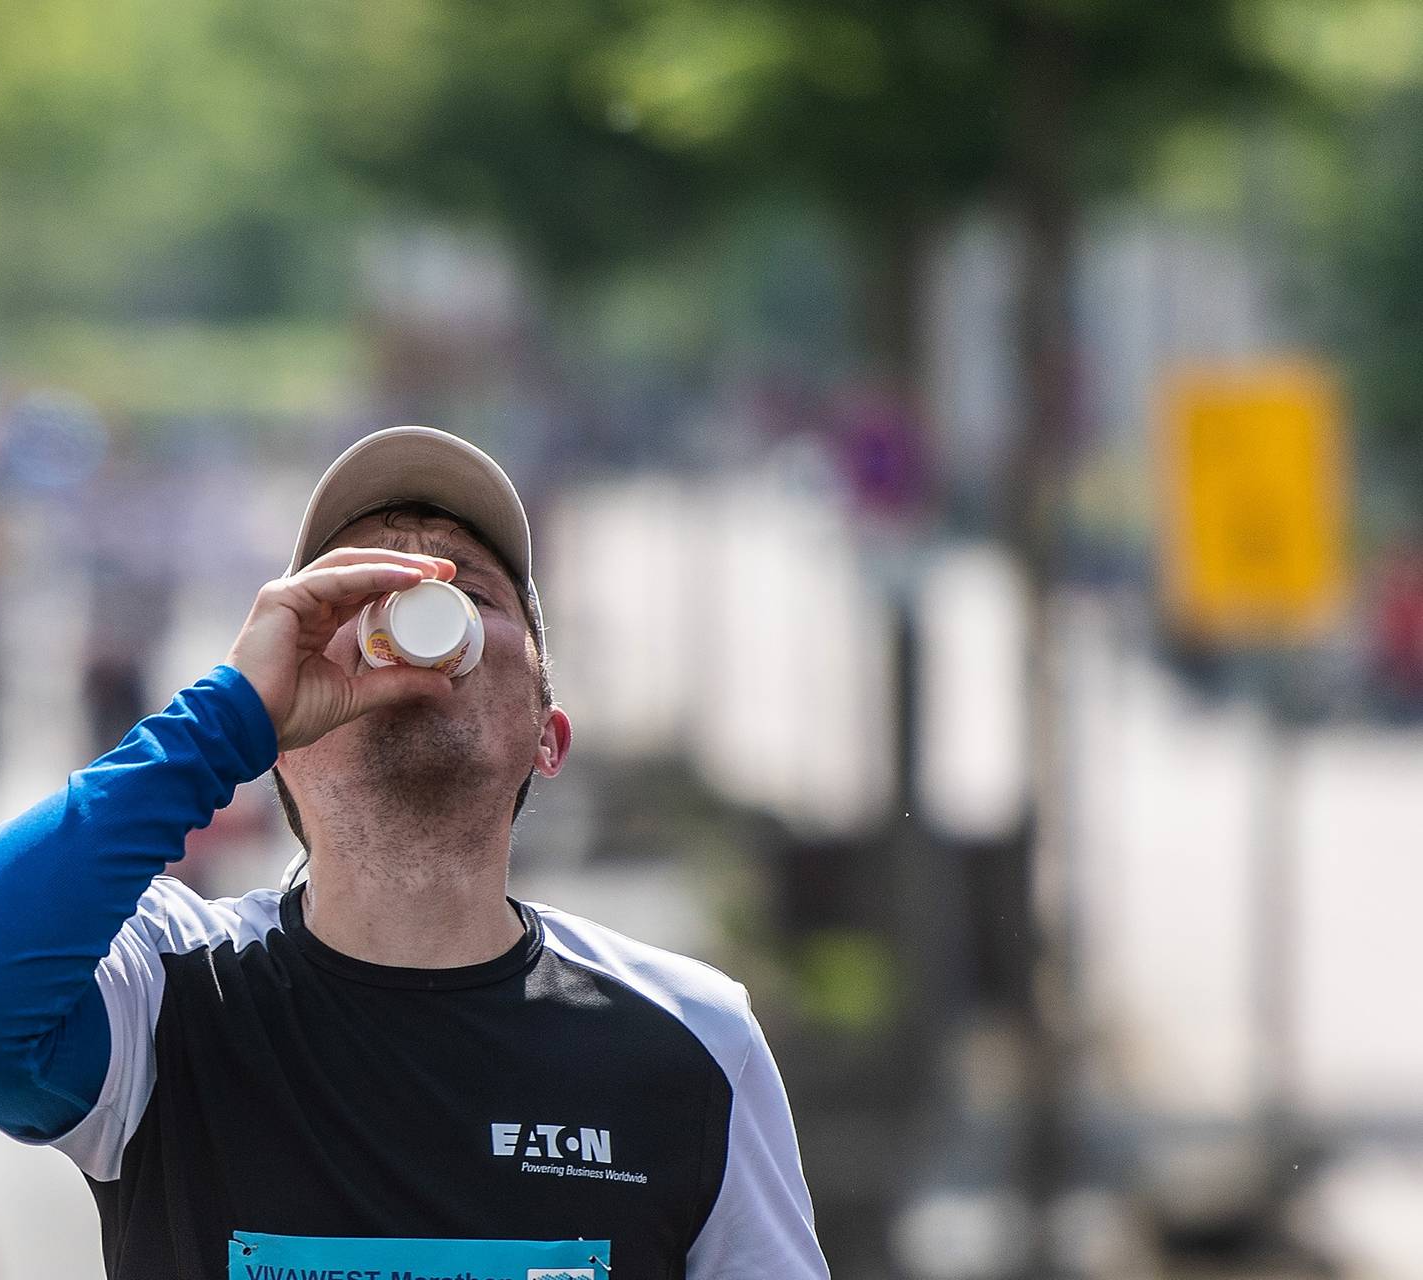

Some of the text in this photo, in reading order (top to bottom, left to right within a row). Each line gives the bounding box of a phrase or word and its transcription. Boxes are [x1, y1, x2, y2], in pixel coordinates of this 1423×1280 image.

[490, 1123, 612, 1164] EATON
[521, 1161, 648, 1184] Powering Business Worldwide
